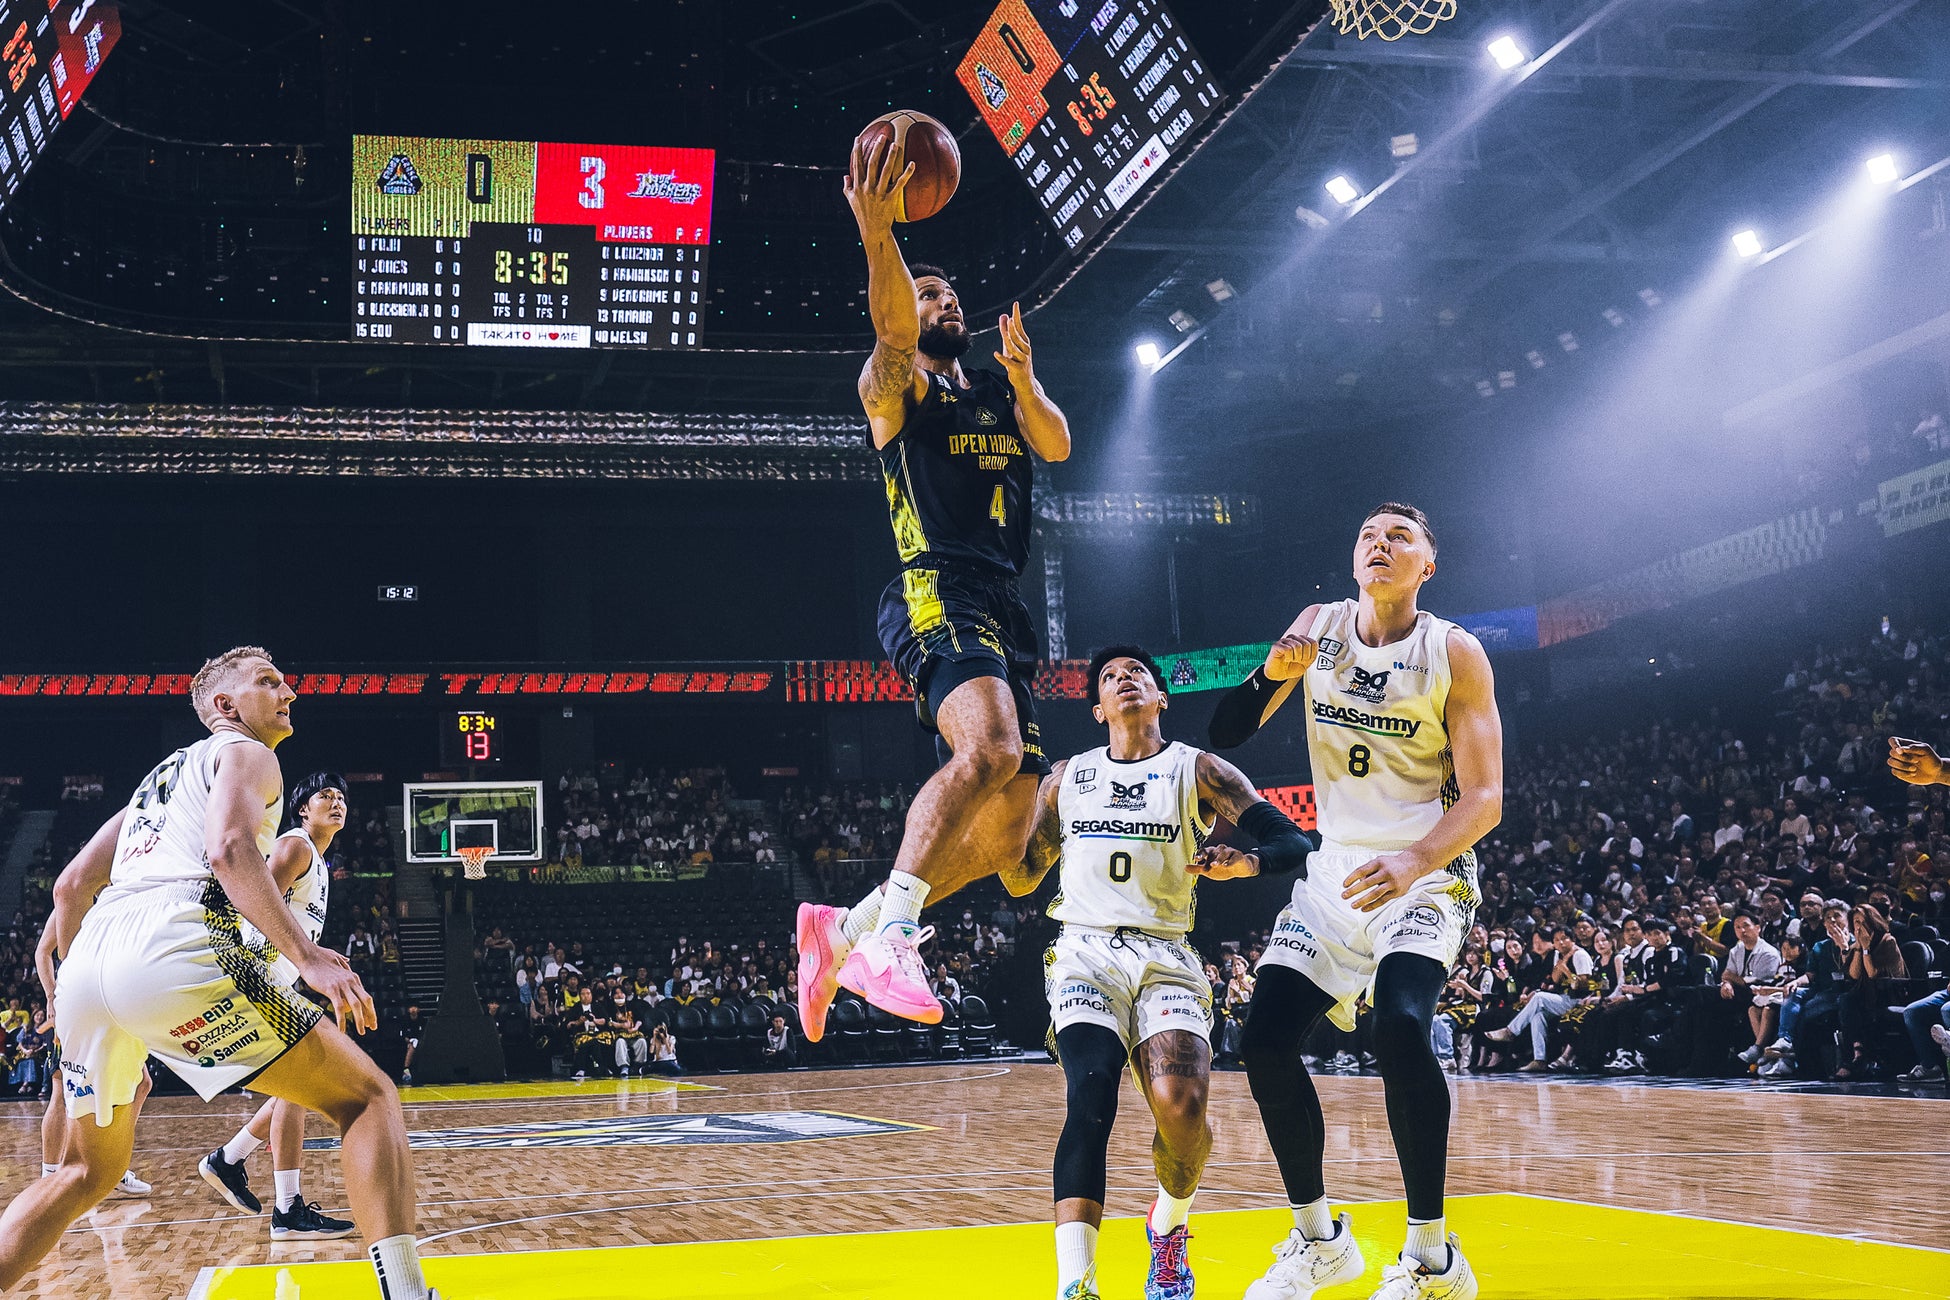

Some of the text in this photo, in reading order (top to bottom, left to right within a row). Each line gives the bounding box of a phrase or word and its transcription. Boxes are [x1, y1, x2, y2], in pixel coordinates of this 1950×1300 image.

[1152, 23, 1164, 39] 0
[999, 22, 1036, 74] 0
[1167, 47, 1179, 61] 0
[2, 20, 37, 93] 8:35
[1067, 72, 1117, 136] 8:35
[467, 154, 493, 204] 0
[578, 157, 607, 209] 3
[604, 225, 703, 241] PLAYERS P F
[358, 238, 366, 251] 0
[453, 240, 461, 254] 0
[676, 249, 684, 262] 3
[694, 249, 700, 262] 1
[358, 259, 366, 273] 4
[371, 259, 408, 274] JONES
[453, 262, 461, 276] 0
[495, 250, 569, 285] 8:35
[692, 270, 700, 284] 0
[357, 281, 366, 295] 6
[434, 283, 442, 297] 0
[452, 283, 460, 297] 0
[493, 292, 569, 306] TOL 2 TOL 2
[674, 291, 681, 304] 0
[691, 291, 698, 304] 0
[357, 302, 365, 316] 8
[434, 304, 442, 318] 0
[451, 304, 460, 318] 0
[493, 306, 567, 319] TFS 0 TFS 1
[597, 309, 609, 323] 13
[672, 311, 680, 325] 0
[689, 311, 697, 325] 0
[356, 323, 459, 339] 15 EDU 0 0
[481, 330, 531, 341] TAKATO
[595, 330, 695, 345] 40 WELSH 0 0
[949, 434, 988, 455] OPEN
[979, 455, 1009, 471] GROUP
[989, 484, 1006, 527] 4
[386, 588, 414, 599] 15:12
[459, 715, 495, 732] 8:34
[1312, 699, 1422, 738] SEGASammy
[466, 732, 489, 759] 13
[1348, 743, 1371, 778] 8
[1071, 820, 1181, 843] SEGASammy
[1109, 851, 1132, 883] 0
[213, 1029, 260, 1062] Sammy
